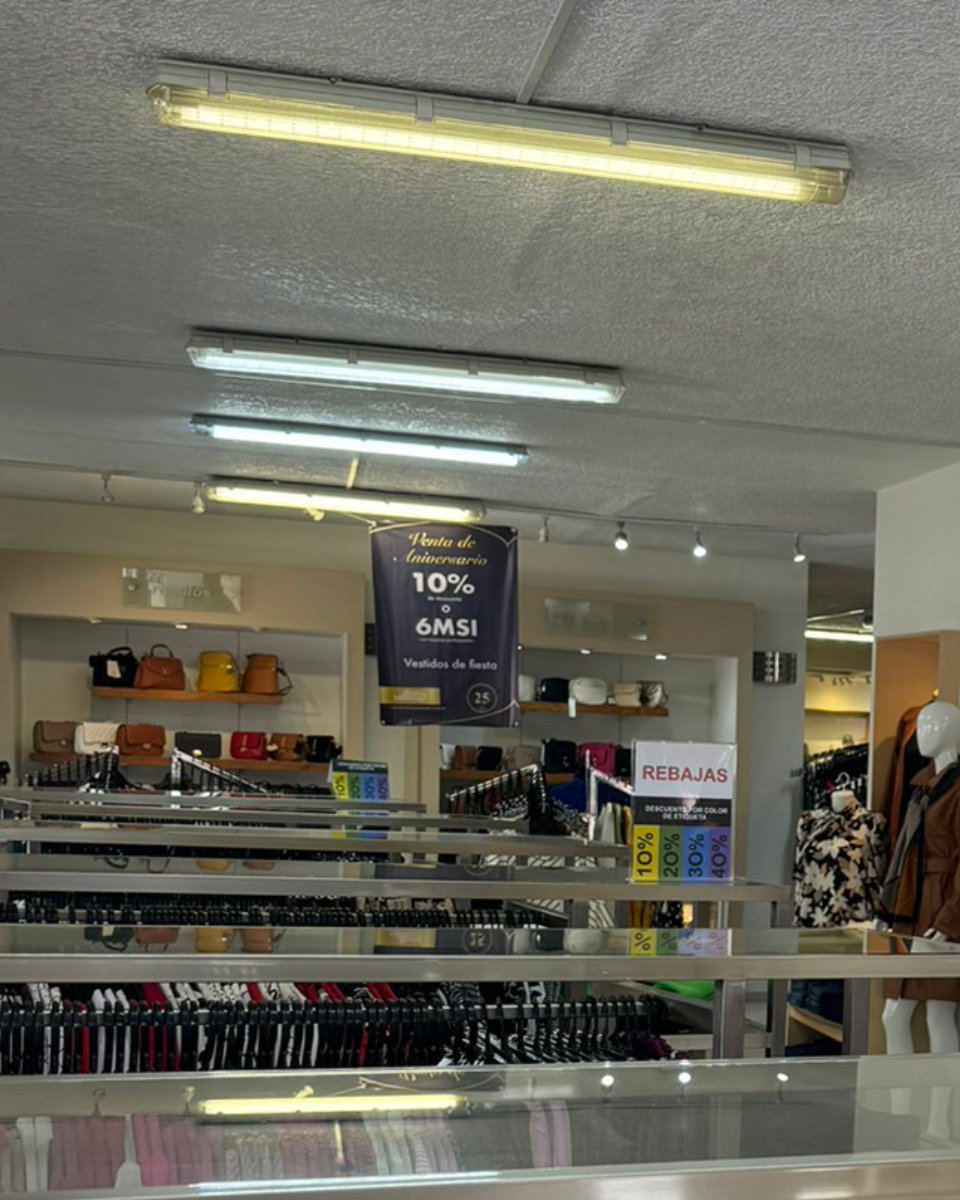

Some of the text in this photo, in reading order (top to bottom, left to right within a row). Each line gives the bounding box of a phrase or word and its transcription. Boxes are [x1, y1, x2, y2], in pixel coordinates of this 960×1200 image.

[408, 532, 476, 548] Venta de
[393, 548, 488, 565] Aniversario
[412, 572, 475, 594] 10%
[415, 617, 477, 637] 6MSI
[403, 658, 497, 670] Vestidos de fiesta
[474, 692, 490, 704] 25
[642, 765, 728, 783] REBAJAS
[704, 807, 728, 815] COLOR
[637, 832, 653, 876] 10%
[663, 833, 680, 877] 20%
[688, 833, 705, 877] 30%
[711, 835, 728, 878] 40%
